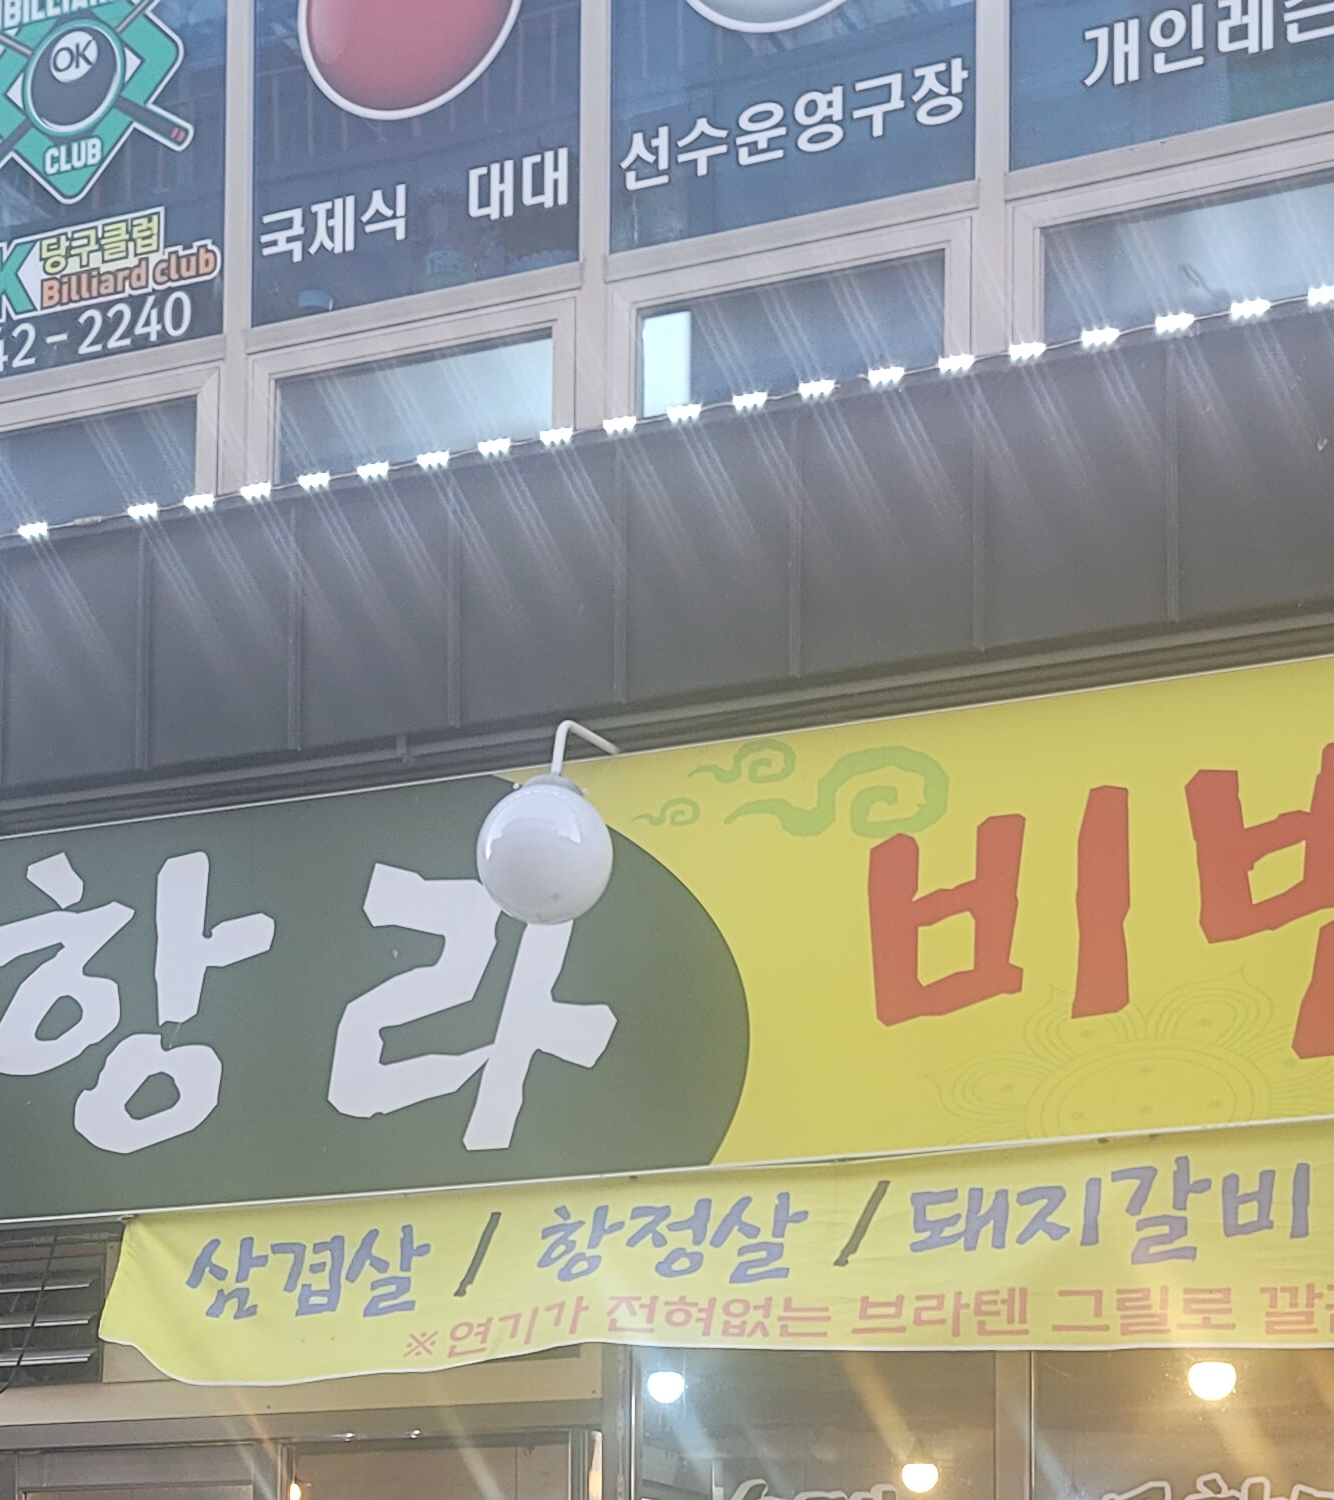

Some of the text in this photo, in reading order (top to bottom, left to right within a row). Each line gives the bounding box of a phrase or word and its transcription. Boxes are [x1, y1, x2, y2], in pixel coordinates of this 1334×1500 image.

[2, 0, 115, 30] BILLI
[53, 37, 96, 72] OK
[45, 138, 101, 175] CLUB
[619, 58, 968, 191] 선수운영구장
[261, 148, 569, 263] 국제식 대대
[40, 211, 159, 275] 당구클럽
[41, 245, 218, 309] Billiard club
[184, 1224, 431, 1318] 삼겹살
[538, 1191, 809, 1282] 항정살
[908, 1155, 1310, 1264] 돼지갈비
[606, 1292, 831, 1340] 전혀없는
[850, 1287, 1029, 1336] 브라텐
[1052, 1279, 1235, 1335] 그릴로
